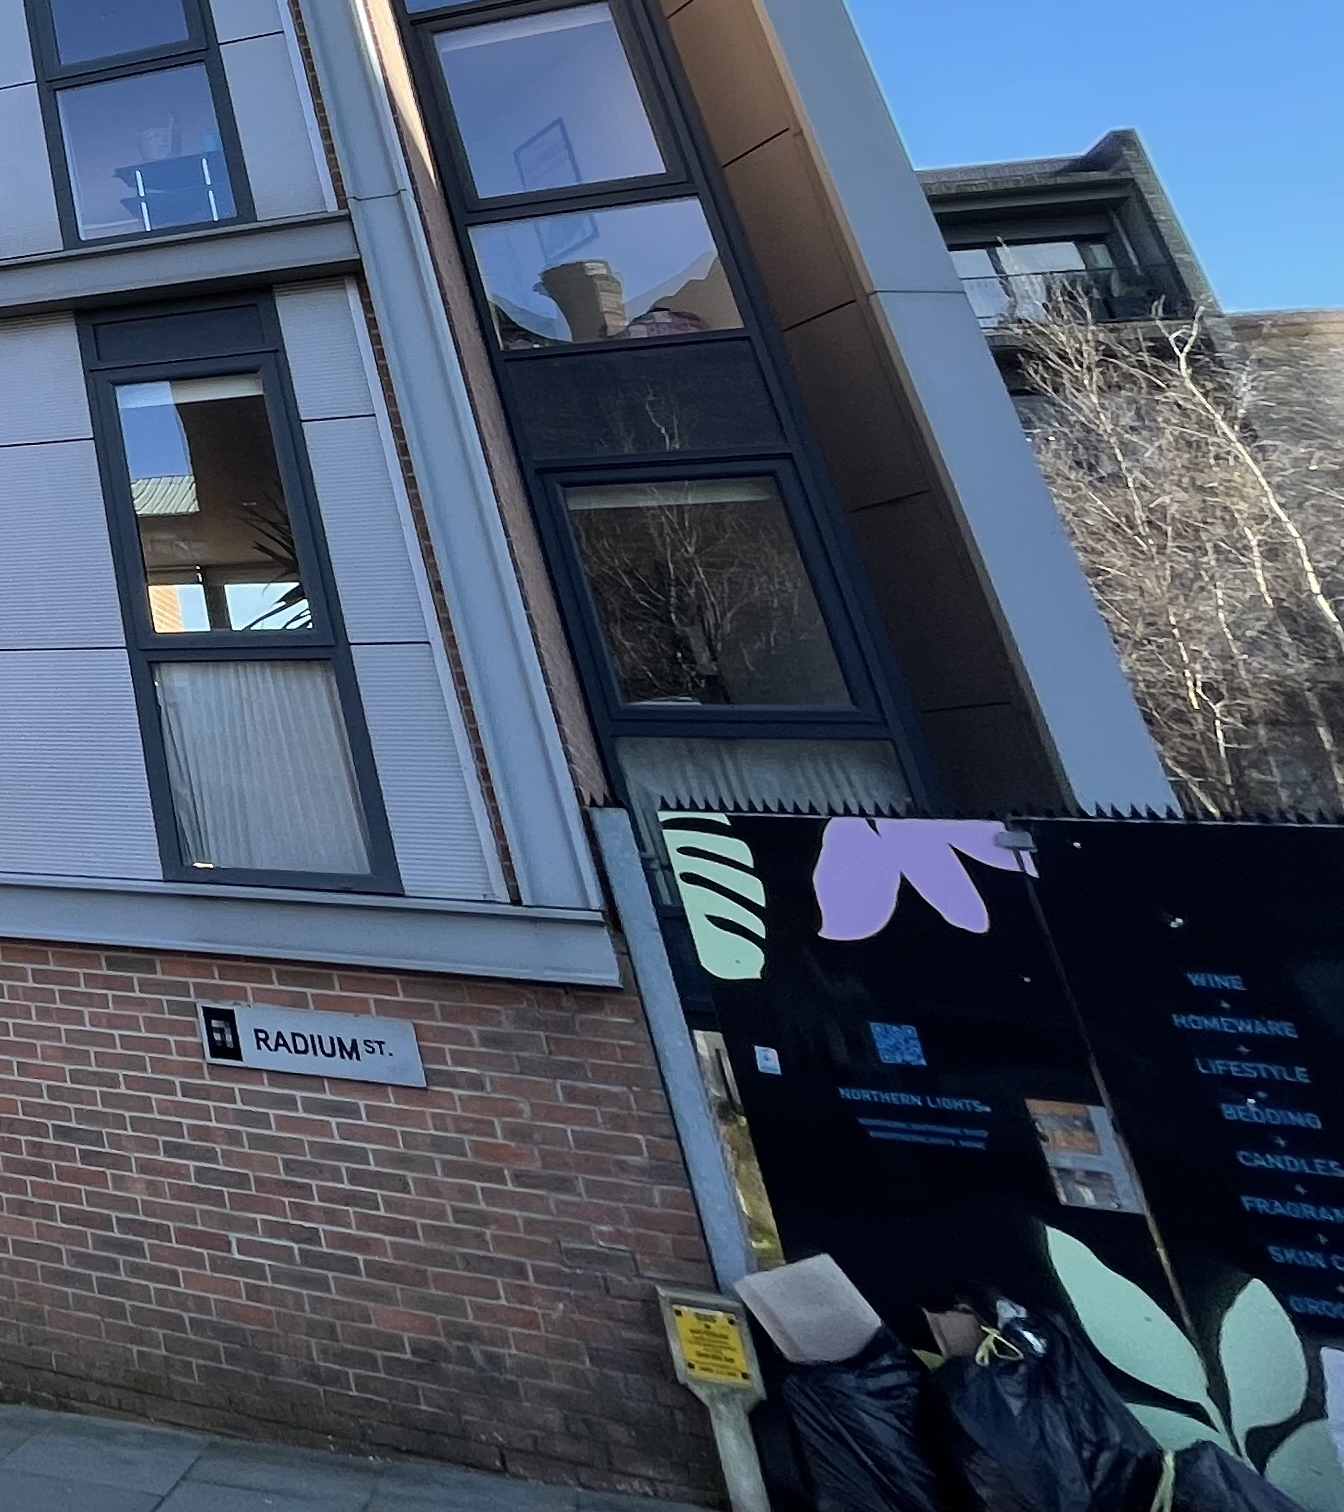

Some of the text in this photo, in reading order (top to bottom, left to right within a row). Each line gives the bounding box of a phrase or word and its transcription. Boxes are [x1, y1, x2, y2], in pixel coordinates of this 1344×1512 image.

[1185, 971, 1246, 991] WINE
[1171, 1013, 1299, 1039] HOMEWARE
[253, 1028, 393, 1062] RADIUM ST.
[1194, 1058, 1311, 1084] LIFESTYLE
[838, 1087, 922, 1106] NORTHERN
[1220, 1103, 1322, 1130] BEDDING
[1236, 1150, 1344, 1178] CANDLES
